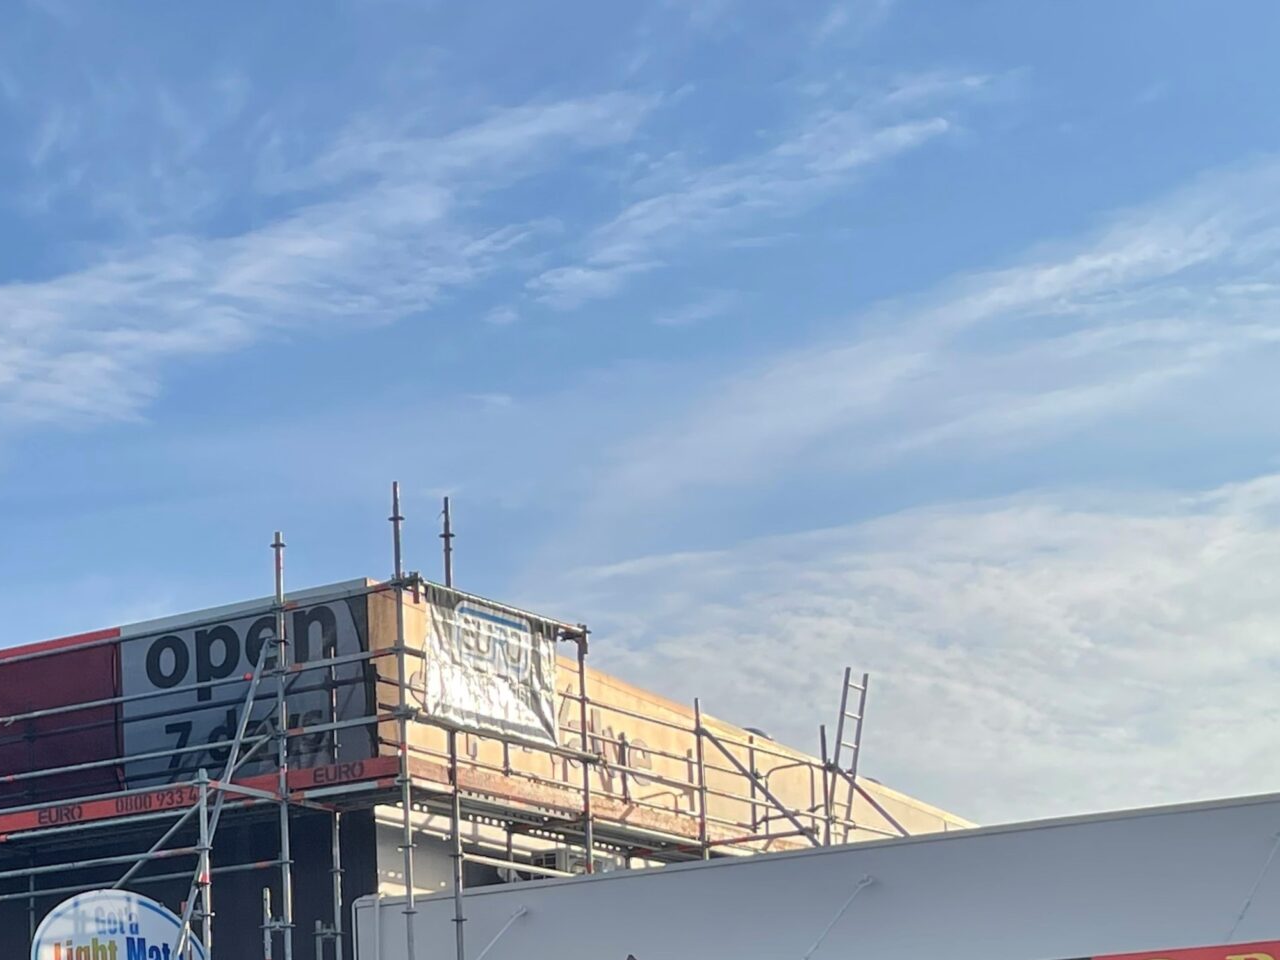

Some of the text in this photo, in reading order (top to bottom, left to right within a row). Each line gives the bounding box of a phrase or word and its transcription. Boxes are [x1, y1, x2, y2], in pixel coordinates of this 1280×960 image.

[146, 604, 337, 702] open
[164, 720, 192, 771] 7
[314, 761, 364, 783] EURO
[38, 805, 83, 825] EURO
[115, 793, 152, 815] 0800
[156, 786, 187, 807] 933
[95, 905, 140, 936] Got'a
